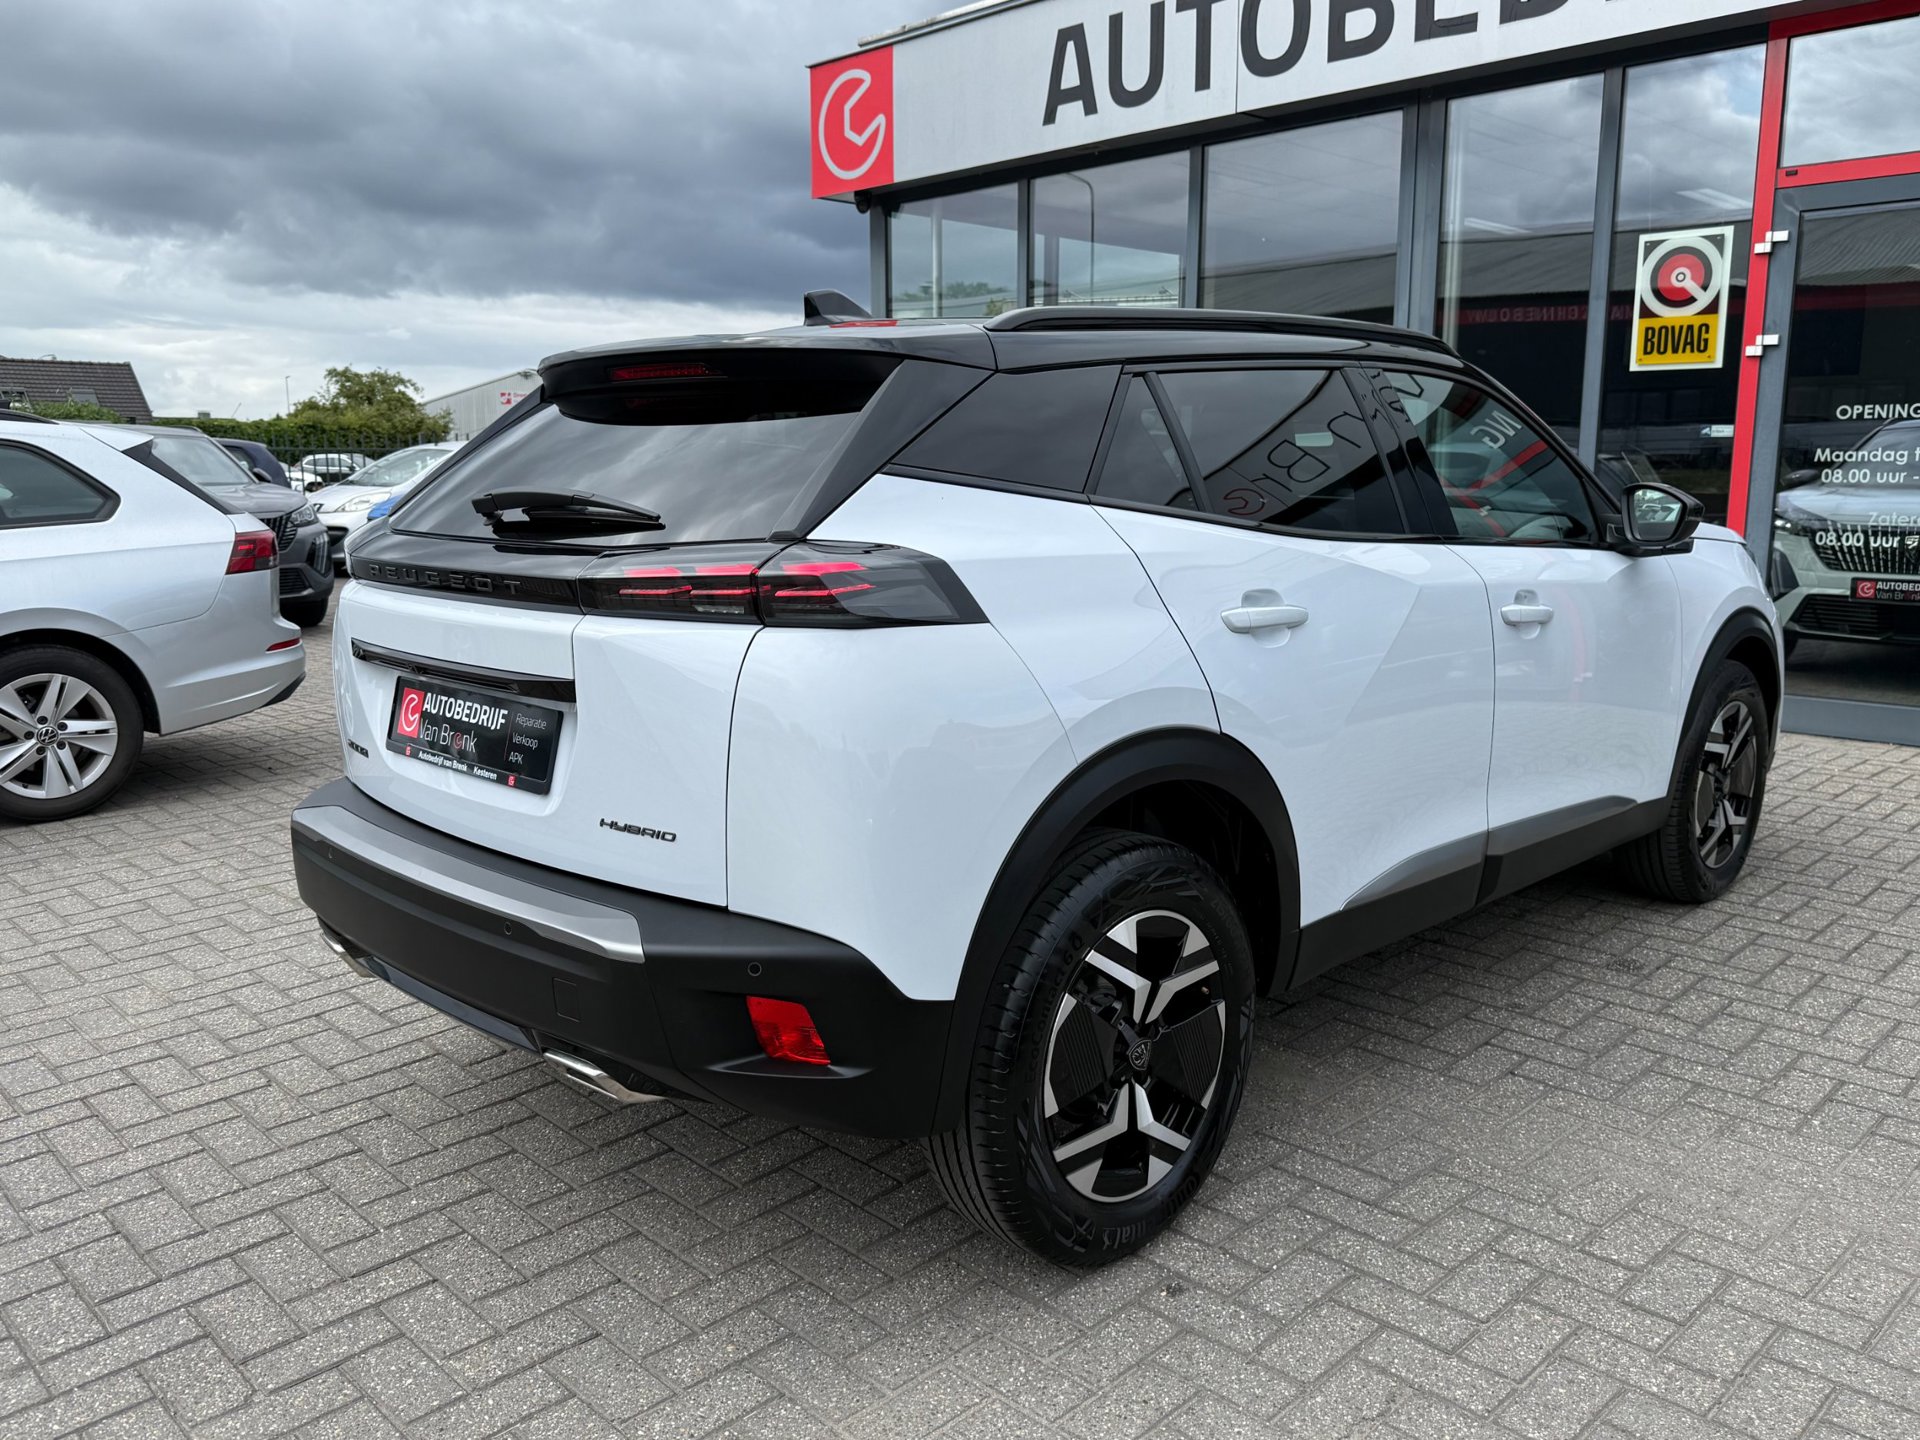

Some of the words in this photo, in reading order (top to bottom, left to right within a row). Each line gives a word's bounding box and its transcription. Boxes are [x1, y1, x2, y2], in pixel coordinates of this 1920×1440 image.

[1042, 0, 1563, 126] AUTOB
[1643, 323, 1710, 355] BOVAG
[1814, 447, 1908, 465] Maandag
[1821, 469, 1870, 483] 08.00
[1877, 471, 1907, 483] uur
[1815, 531, 1864, 546] 08.00
[1871, 535, 1900, 548] uur
[369, 564, 521, 595] PEUGEOT
[422, 692, 508, 730] AUTOBEDRIJF
[515, 713, 547, 730] Reparatie
[419, 717, 438, 742] Van
[512, 732, 538, 750] Verkoop
[418, 750, 443, 766] Autobedrijf
[443, 758, 452, 767] van
[452, 760, 468, 772] Brenk
[473, 766, 498, 780] Kesteren
[508, 751, 524, 765] APK
[599, 818, 677, 842] HYBRID
